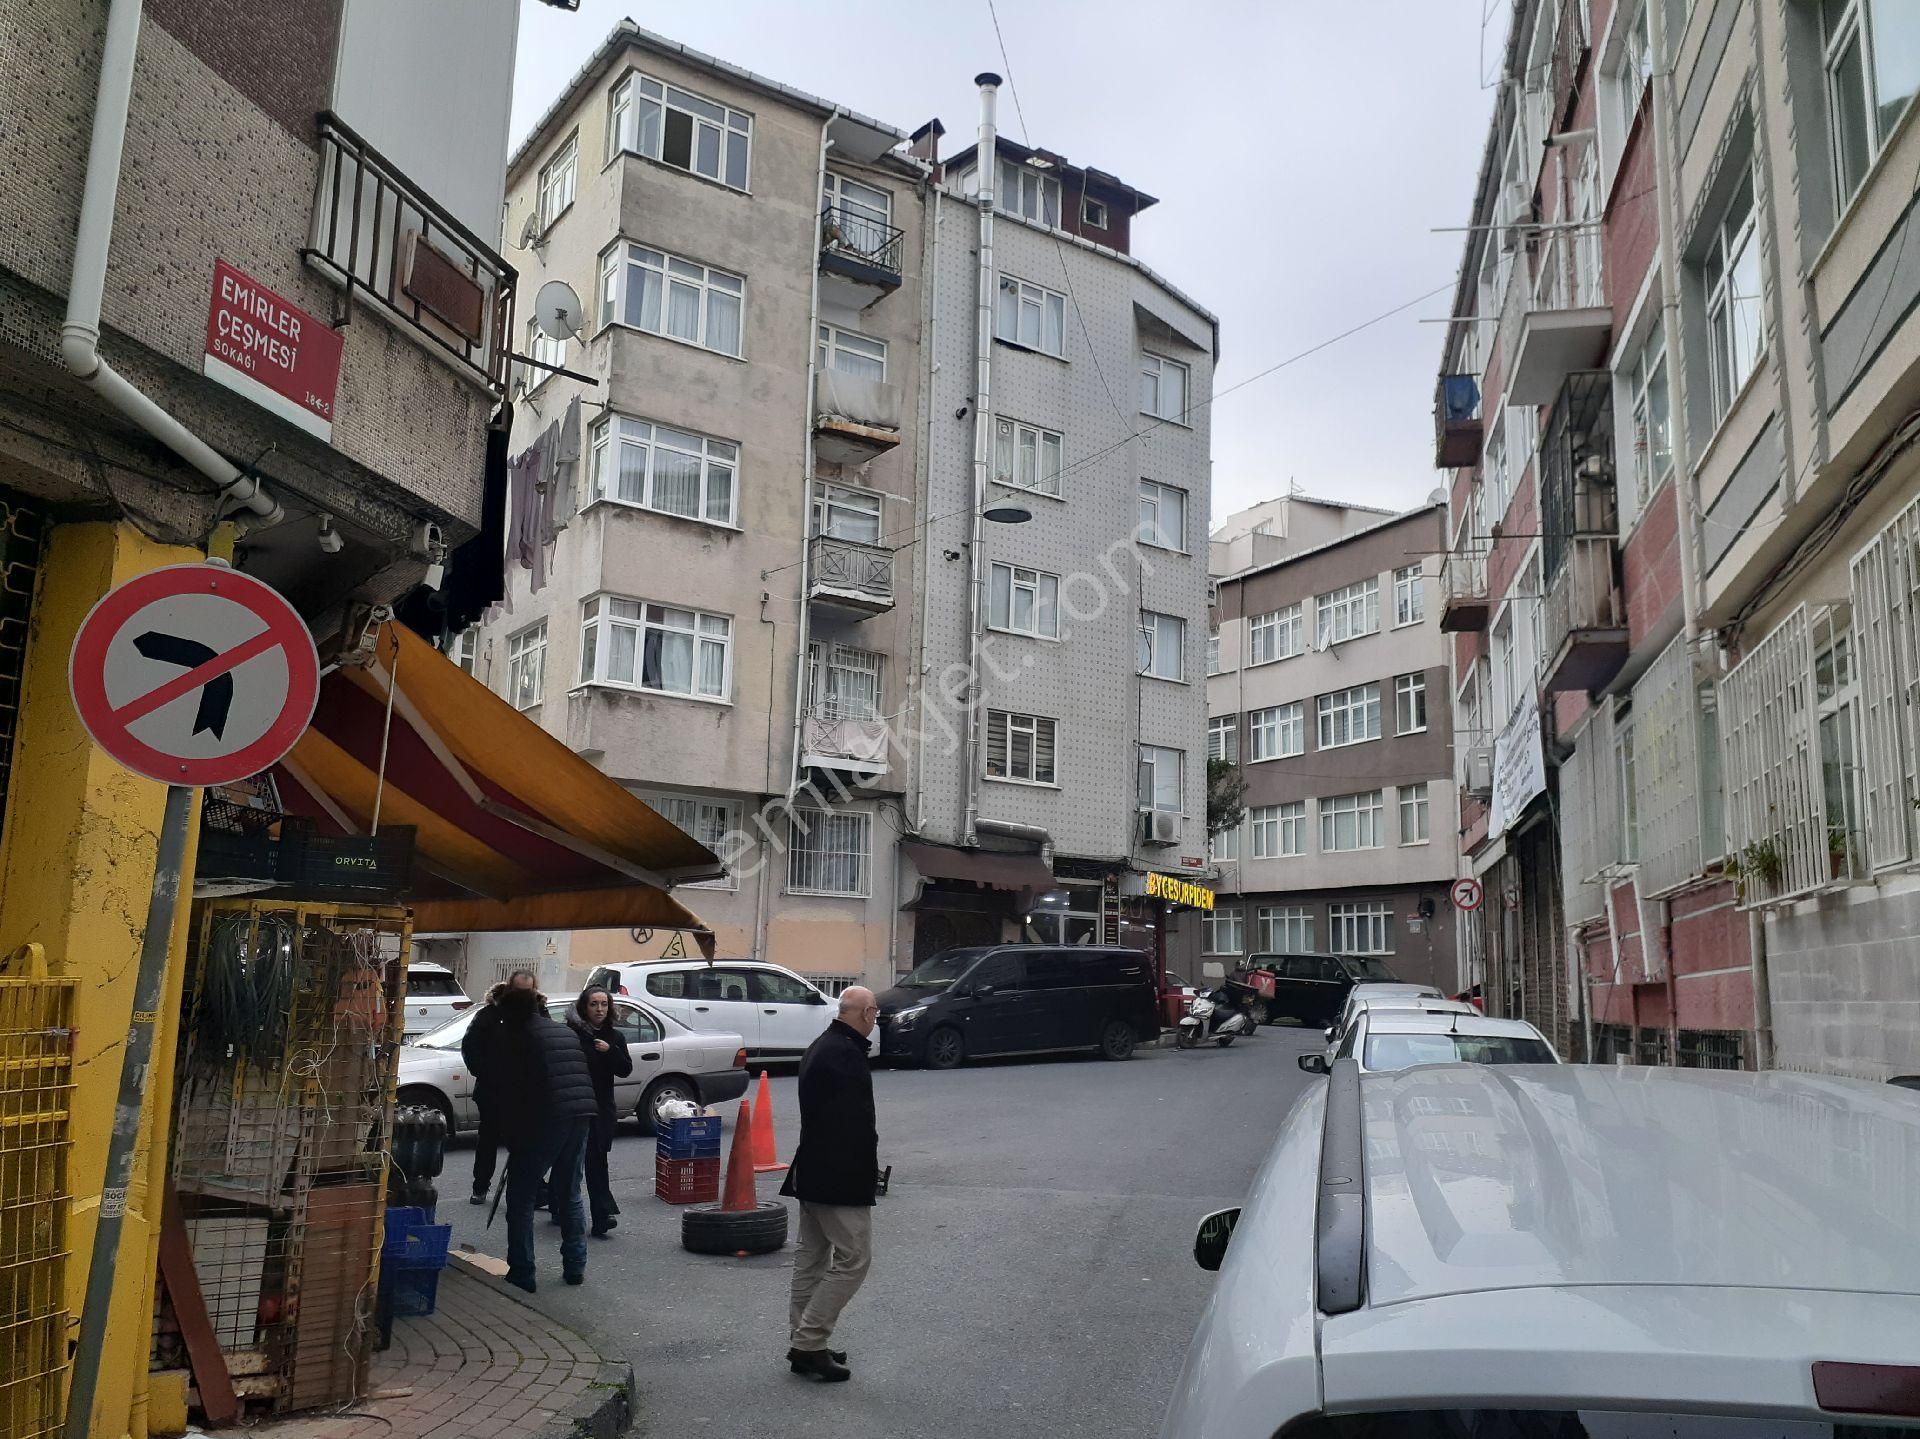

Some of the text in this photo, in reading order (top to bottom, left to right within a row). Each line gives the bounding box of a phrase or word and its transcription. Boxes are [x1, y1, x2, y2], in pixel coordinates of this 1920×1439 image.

[220, 275, 301, 342] EMİRLER
[213, 338, 256, 372] SOKAĞI
[217, 309, 298, 373] ÇEŞMESİ
[335, 856, 377, 869] ORVITA
